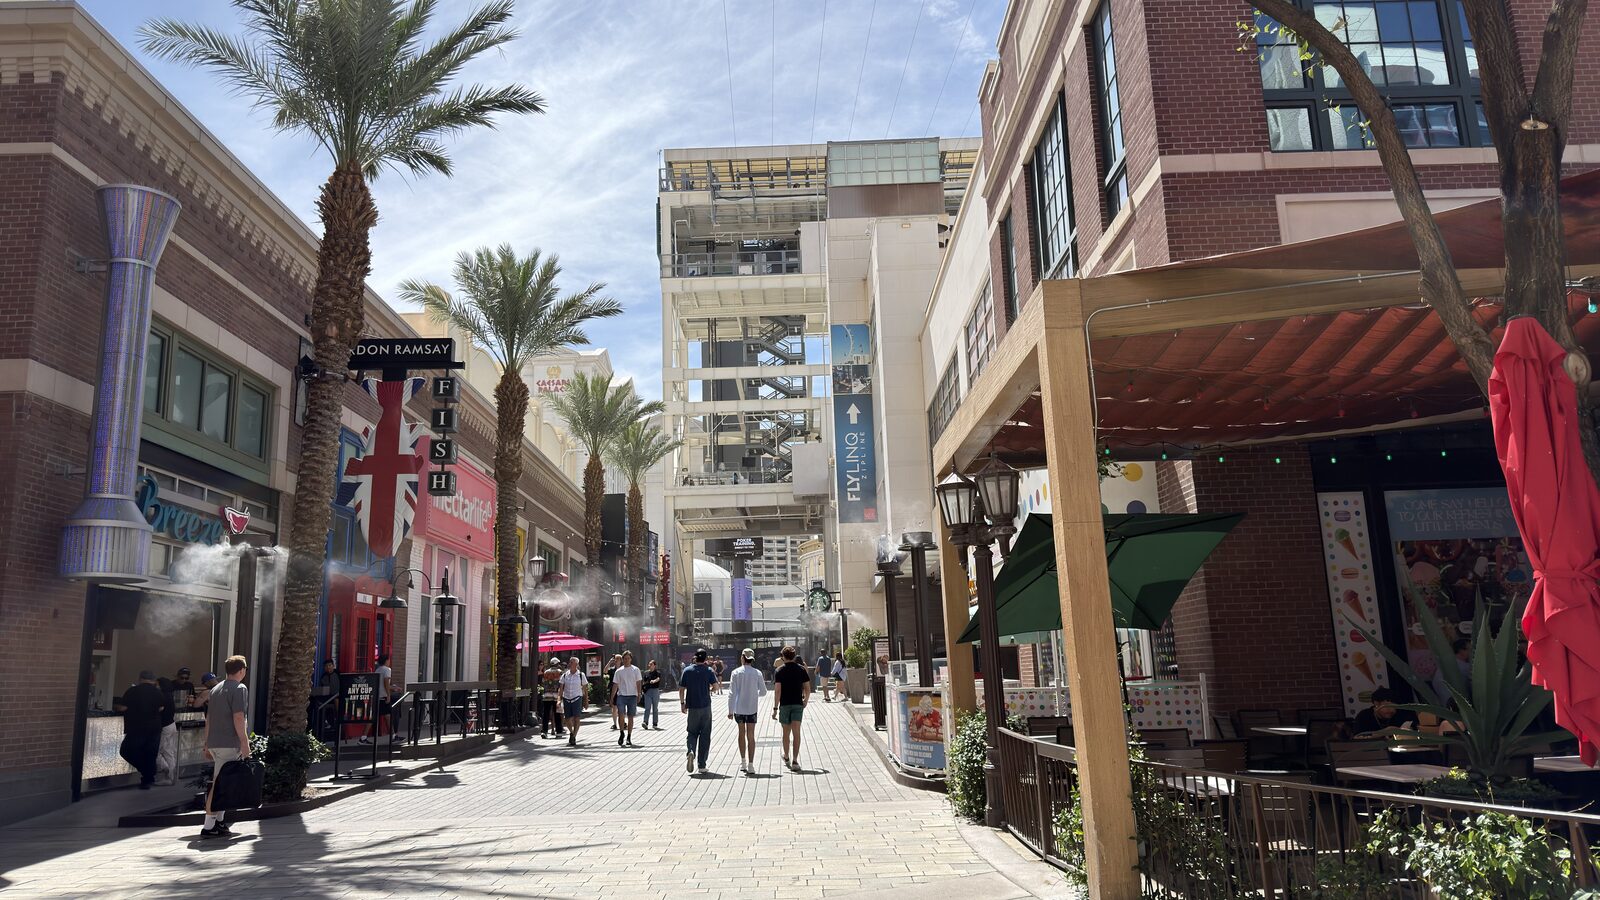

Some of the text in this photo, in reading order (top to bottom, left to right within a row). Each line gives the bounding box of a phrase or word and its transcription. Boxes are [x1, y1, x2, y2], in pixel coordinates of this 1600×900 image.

[350, 344, 450, 355] DON RAMSAY
[431, 380, 450, 489] FISH
[845, 432, 861, 501] FLYLINQ
[1441, 499, 1463, 509] SAY
[1399, 511, 1415, 521] TO
[1417, 511, 1443, 520] OUR
[1415, 521, 1451, 532] LITTLE
